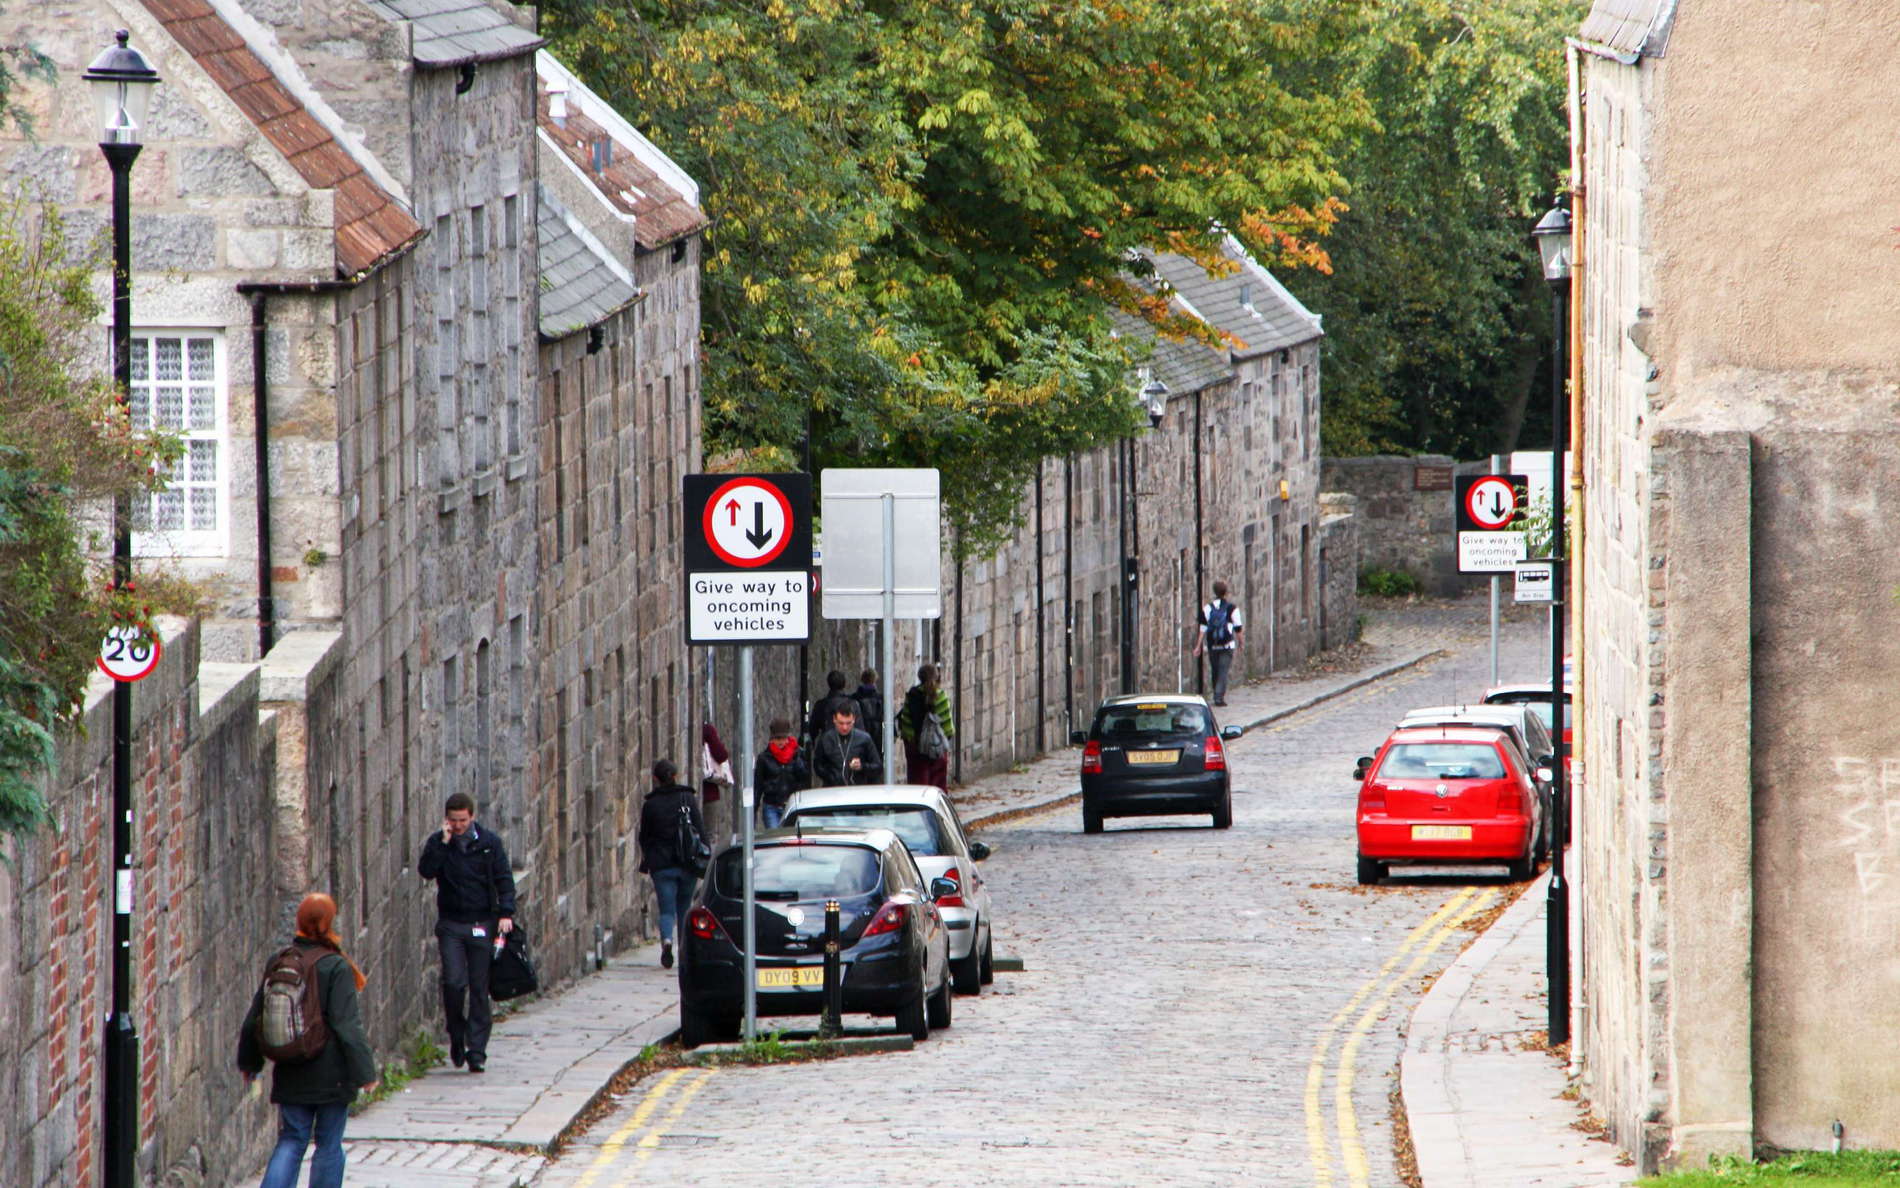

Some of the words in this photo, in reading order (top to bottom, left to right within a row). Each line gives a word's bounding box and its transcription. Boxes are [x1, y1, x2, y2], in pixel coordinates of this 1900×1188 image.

[1462, 536, 1484, 545] Give
[1489, 537, 1508, 546] way
[1513, 536, 1523, 544] to
[1469, 547, 1517, 557] oncoming
[1473, 558, 1514, 566] vehicles
[694, 580, 734, 594] Give
[742, 582, 776, 597] way
[784, 579, 803, 593] to
[707, 598, 792, 615] oncoming
[713, 617, 785, 631] vehicles
[106, 637, 150, 663] 20
[764, 970, 800, 985] DY09
[803, 968, 820, 982] VV
